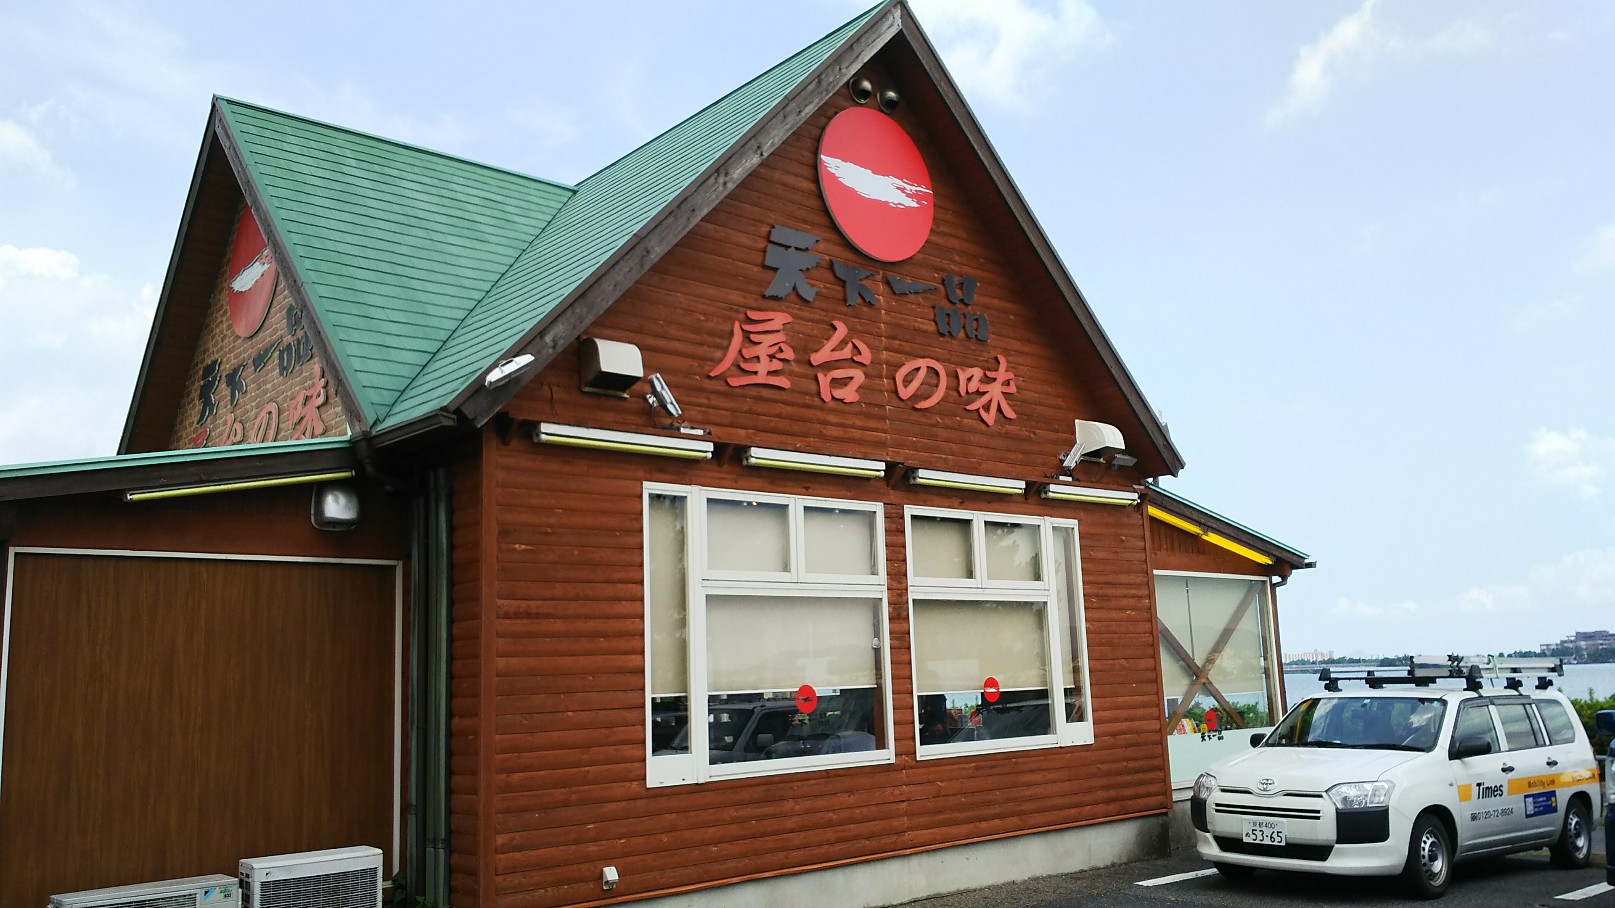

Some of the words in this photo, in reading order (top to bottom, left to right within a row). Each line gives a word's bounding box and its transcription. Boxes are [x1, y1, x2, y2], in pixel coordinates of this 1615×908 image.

[763, 224, 989, 341] 天下一品
[709, 310, 1017, 426] 屋台の味
[1476, 781, 1504, 800] Times
[1251, 829, 1282, 843] 53-65
